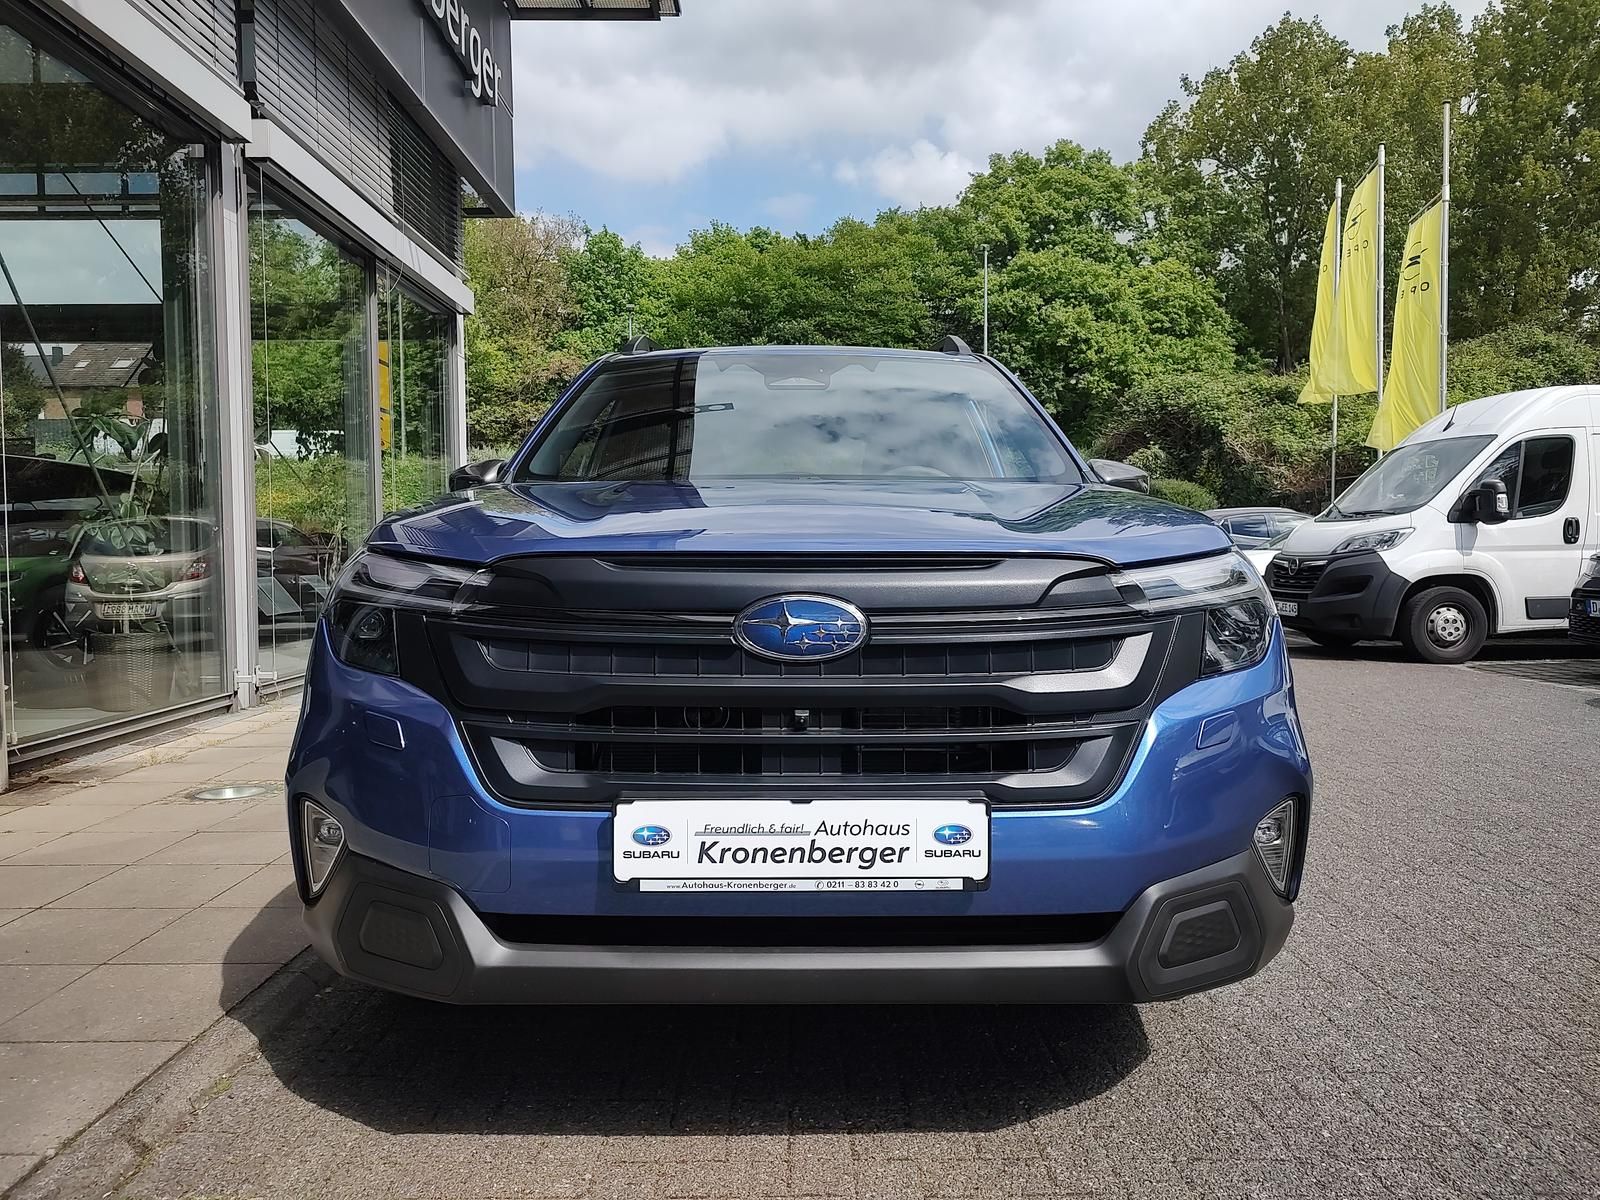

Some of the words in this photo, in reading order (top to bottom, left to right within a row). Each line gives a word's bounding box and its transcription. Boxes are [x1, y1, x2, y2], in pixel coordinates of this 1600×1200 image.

[703, 823, 765, 834] Freundlich
[768, 823, 776, 834] &
[779, 822, 805, 834] fair!
[814, 818, 910, 836] Autohaus
[622, 850, 680, 859] SUBARU
[697, 838, 911, 870] Kronenberger
[924, 849, 982, 858] SUBARU
[666, 880, 797, 891] www.Autohaus-Kronenberger.de
[826, 881, 845, 889] 0211
[854, 880, 865, 888] 83
[867, 880, 878, 888] 83
[880, 880, 891, 888] 42
[893, 880, 899, 888] 0
